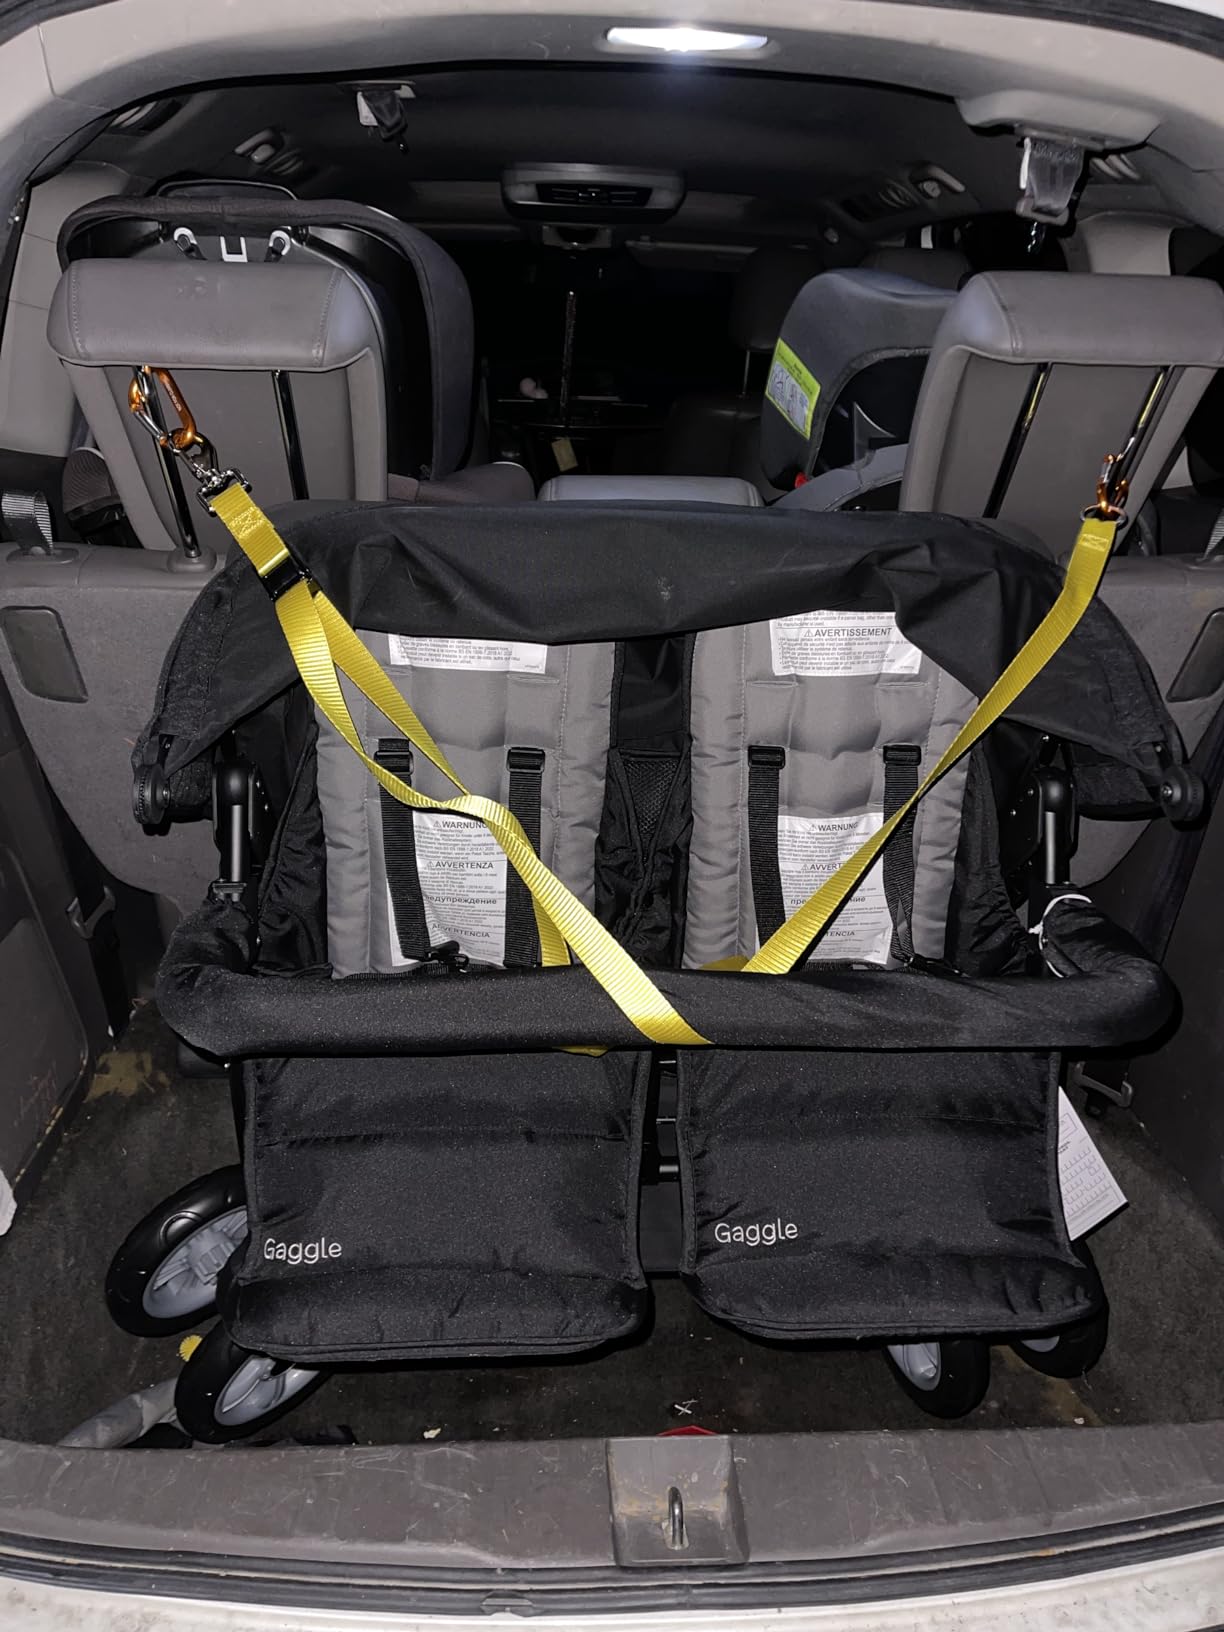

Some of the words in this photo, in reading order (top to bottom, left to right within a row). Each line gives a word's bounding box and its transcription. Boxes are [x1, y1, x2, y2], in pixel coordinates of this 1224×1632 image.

[815, 628, 892, 637] AVERTISSEMENT
[818, 822, 859, 831] WARNUNG
[435, 861, 494, 869] AVVERTENZA
[810, 863, 842, 871] AVVERT
[426, 896, 497, 905] едупреждение
[714, 1217, 799, 1247] Gaggle
[263, 1237, 342, 1265] Gaggle
